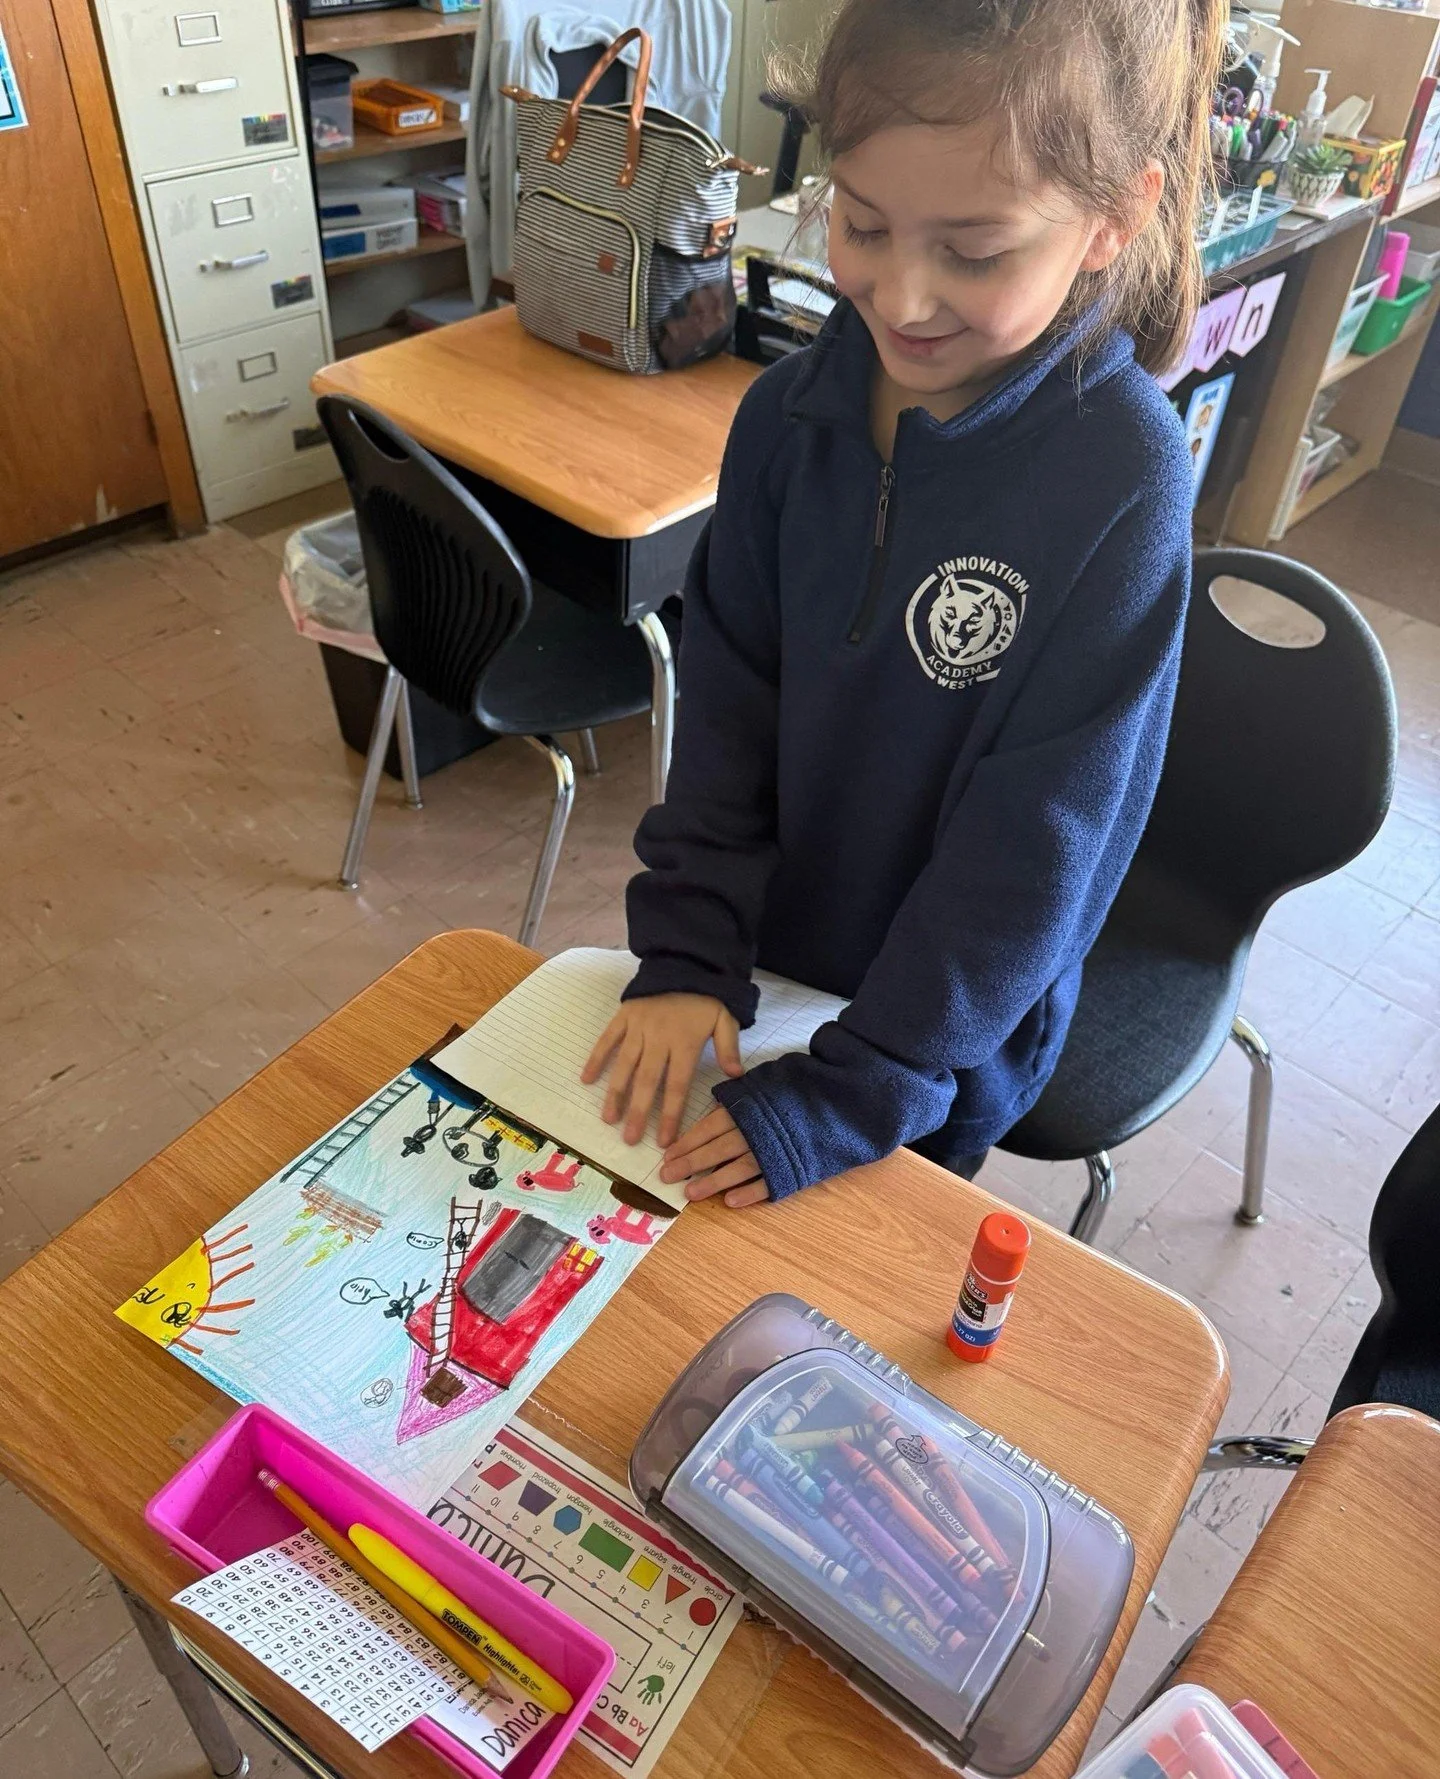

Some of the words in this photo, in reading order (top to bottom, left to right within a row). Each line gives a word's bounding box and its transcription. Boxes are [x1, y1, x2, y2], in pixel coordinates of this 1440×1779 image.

[937, 556, 1030, 594] INNOVATION
[926, 654, 992, 678] ACADEMY
[936, 675, 974, 690] WEST
[500, 1450, 527, 1470] rhombus
[470, 1483, 480, 1494] 11
[532, 1472, 562, 1494] trapezoid
[490, 1496, 502, 1508] 10
[566, 1493, 593, 1515] hexagon
[512, 1511, 520, 1521] 9
[925, 1490, 966, 1534] Crayola
[532, 1525, 542, 1534] 8
[602, 1518, 634, 1542] rectangle
[292, 1541, 305, 1550] 90
[301, 1534, 319, 1546] 100
[554, 1540, 562, 1550] 7
[279, 1547, 294, 1556] 80
[323, 1550, 335, 1559] 99
[643, 1546, 668, 1564] square
[254, 1559, 268, 1567] 60
[267, 1553, 281, 1562] 70
[312, 1556, 326, 1564] 89
[576, 1554, 584, 1565] 6
[240, 1565, 255, 1574] 50
[300, 1562, 314, 1570] 79
[340, 1561, 352, 1572] 98
[226, 1572, 241, 1580] 40
[287, 1568, 301, 1576] 69
[329, 1568, 343, 1578] 88
[596, 1569, 606, 1580] 5
[671, 1564, 698, 1585] triangle
[274, 1574, 289, 1582] 59
[317, 1574, 331, 1584] 78
[211, 1580, 227, 1589] 30
[304, 1580, 318, 1589] 68
[345, 1583, 360, 1591] 87
[618, 1584, 627, 1594] 4
[196, 1588, 213, 1597] 20
[247, 1588, 262, 1596] 39
[292, 1586, 306, 1596] 58
[333, 1589, 348, 1598] 77
[704, 1585, 724, 1601] circle
[181, 1596, 196, 1605] 10
[233, 1595, 249, 1604] 29
[279, 1593, 292, 1602] 48
[363, 1595, 377, 1605] 86
[218, 1602, 233, 1611] 19
[265, 1600, 280, 1610] 38
[308, 1602, 324, 1610] 57
[352, 1601, 366, 1612] 76
[641, 1599, 650, 1610] 3
[251, 1607, 267, 1617] 28
[295, 1608, 310, 1616] 47
[340, 1607, 354, 1617] 66
[379, 1609, 394, 1619] 85
[236, 1614, 251, 1625] 18
[282, 1615, 298, 1624] 37
[328, 1614, 342, 1624] 56
[368, 1615, 383, 1626] 75
[662, 1613, 672, 1624] 2
[268, 1623, 285, 1632] 27
[315, 1621, 329, 1630] 46
[356, 1622, 371, 1631] 65
[397, 1623, 412, 1634] 84
[442, 1609, 481, 1646] TOMPEN
[254, 1630, 269, 1639] 17
[302, 1628, 316, 1639] 36
[344, 1628, 360, 1638] 55
[386, 1629, 401, 1640] 74
[688, 1630, 694, 1640] 1
[288, 1636, 304, 1647] 26
[332, 1635, 347, 1645] 45
[375, 1636, 389, 1646] 64
[416, 1638, 430, 1648] 83
[274, 1643, 288, 1654] 16
[318, 1642, 335, 1654] 35
[362, 1643, 378, 1654] 54
[404, 1644, 419, 1656] 73
[305, 1650, 322, 1662] 25
[350, 1650, 365, 1660] 44
[393, 1651, 408, 1661] 63
[433, 1652, 448, 1664] 82
[483, 1644, 520, 1676] Highlighter
[292, 1658, 306, 1670] 15
[338, 1657, 354, 1668] 34
[382, 1658, 396, 1669] 53
[422, 1658, 437, 1671] 72
[656, 1656, 676, 1674] left
[325, 1665, 341, 1676] 24
[370, 1665, 384, 1675] 43
[411, 1666, 426, 1676] 62
[453, 1668, 465, 1679] 81
[311, 1673, 326, 1685] 14
[357, 1673, 372, 1684] 33
[400, 1673, 414, 1684] 52
[442, 1675, 456, 1686] 71
[344, 1680, 361, 1692] 23
[388, 1680, 403, 1691] 42
[431, 1683, 444, 1692] 61
[330, 1689, 345, 1701] 13
[376, 1687, 391, 1700] 32
[420, 1690, 434, 1700] 51
[363, 1696, 380, 1708] 22
[408, 1698, 422, 1708] 41
[596, 1694, 609, 1710] C
[350, 1704, 365, 1717] 12
[396, 1705, 410, 1717] 31
[612, 1704, 629, 1724] Bb
[340, 1716, 351, 1724] 2
[384, 1713, 399, 1725] 21
[370, 1722, 384, 1734] 11
[480, 1702, 546, 1757] Danica
[629, 1716, 649, 1736] Aa
